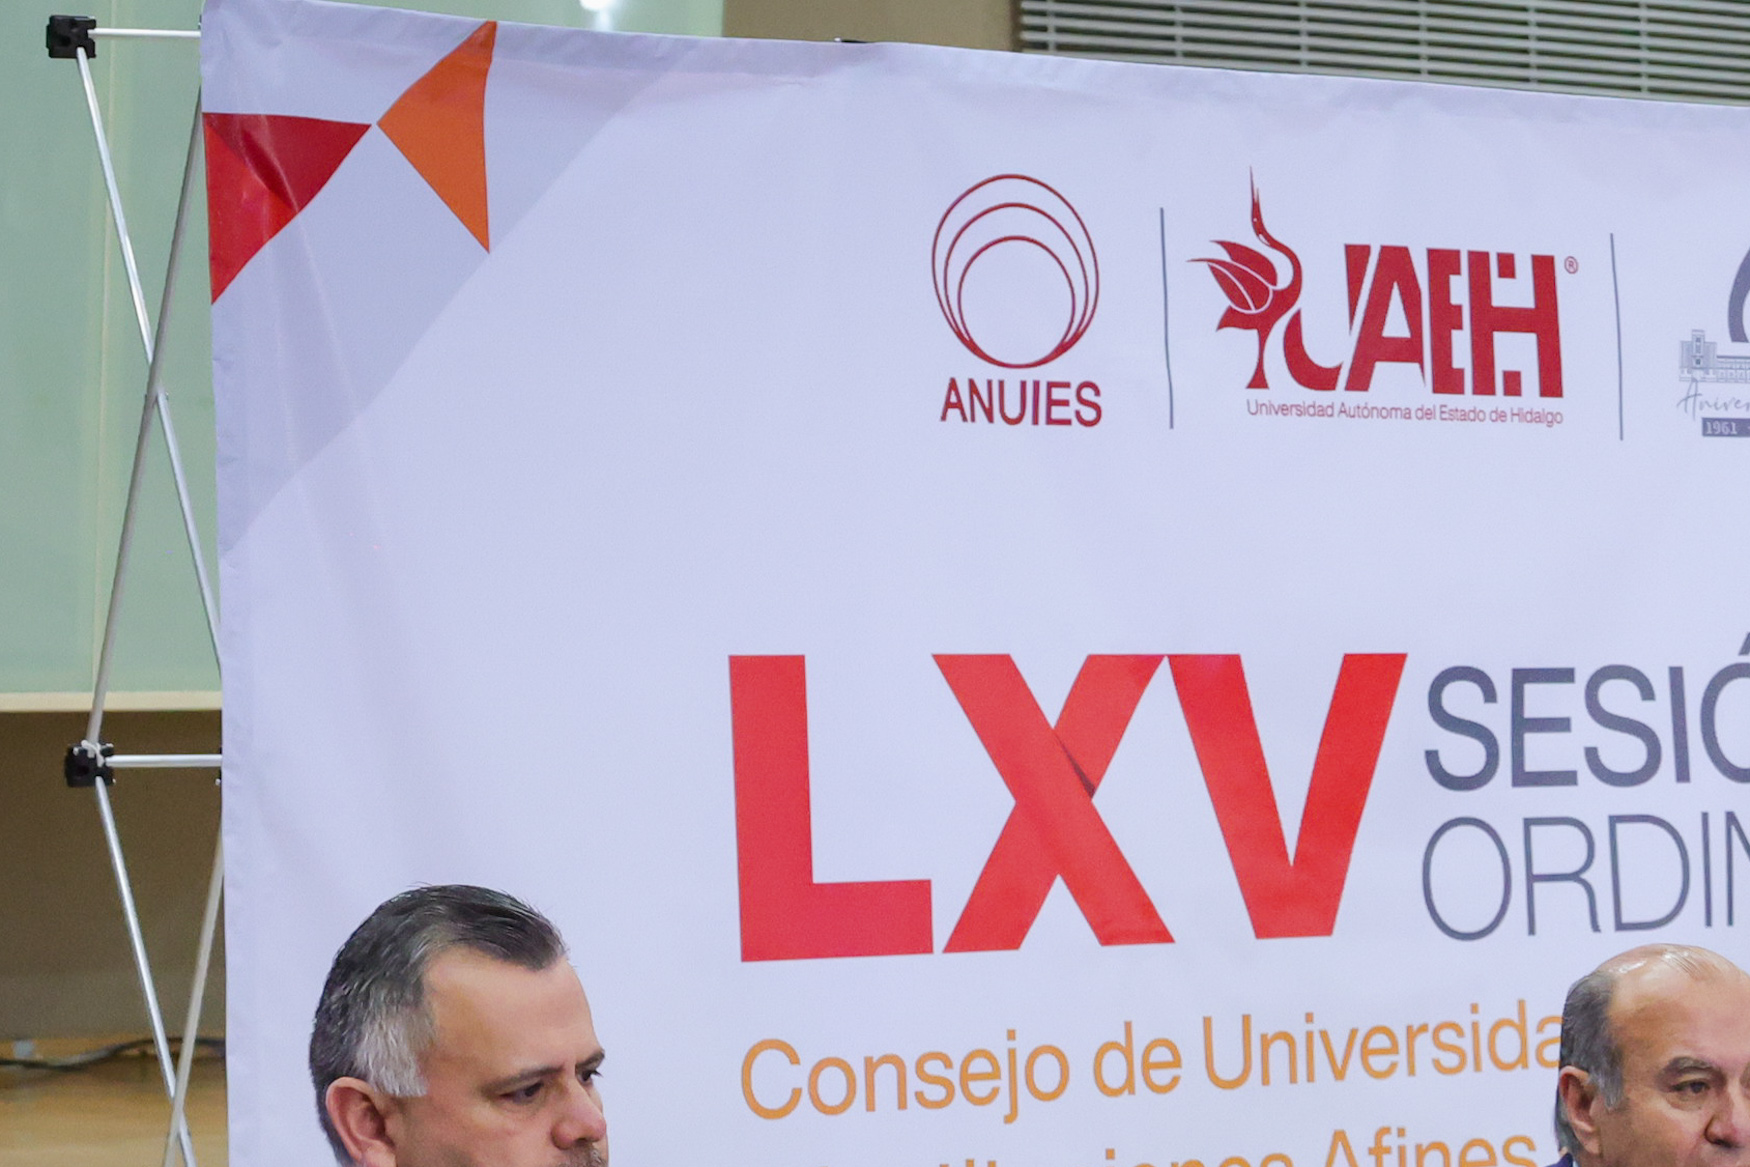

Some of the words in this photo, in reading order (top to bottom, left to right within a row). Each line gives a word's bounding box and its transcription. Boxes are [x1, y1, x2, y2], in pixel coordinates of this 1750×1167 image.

[940, 377, 1102, 427] ANUIES
[1246, 399, 1334, 418] Universidad
[1338, 401, 1412, 420] Autónoma
[1415, 403, 1437, 421] del
[1439, 404, 1486, 423] Estado
[1489, 406, 1507, 423] de
[1511, 407, 1564, 428] Hidalgo
[1705, 421, 1738, 435] 1961
[729, 652, 1408, 963] LXV
[741, 1028, 1071, 1124] Consejo
[1093, 1020, 1183, 1098] de
[1203, 999, 1564, 1090] Universida
